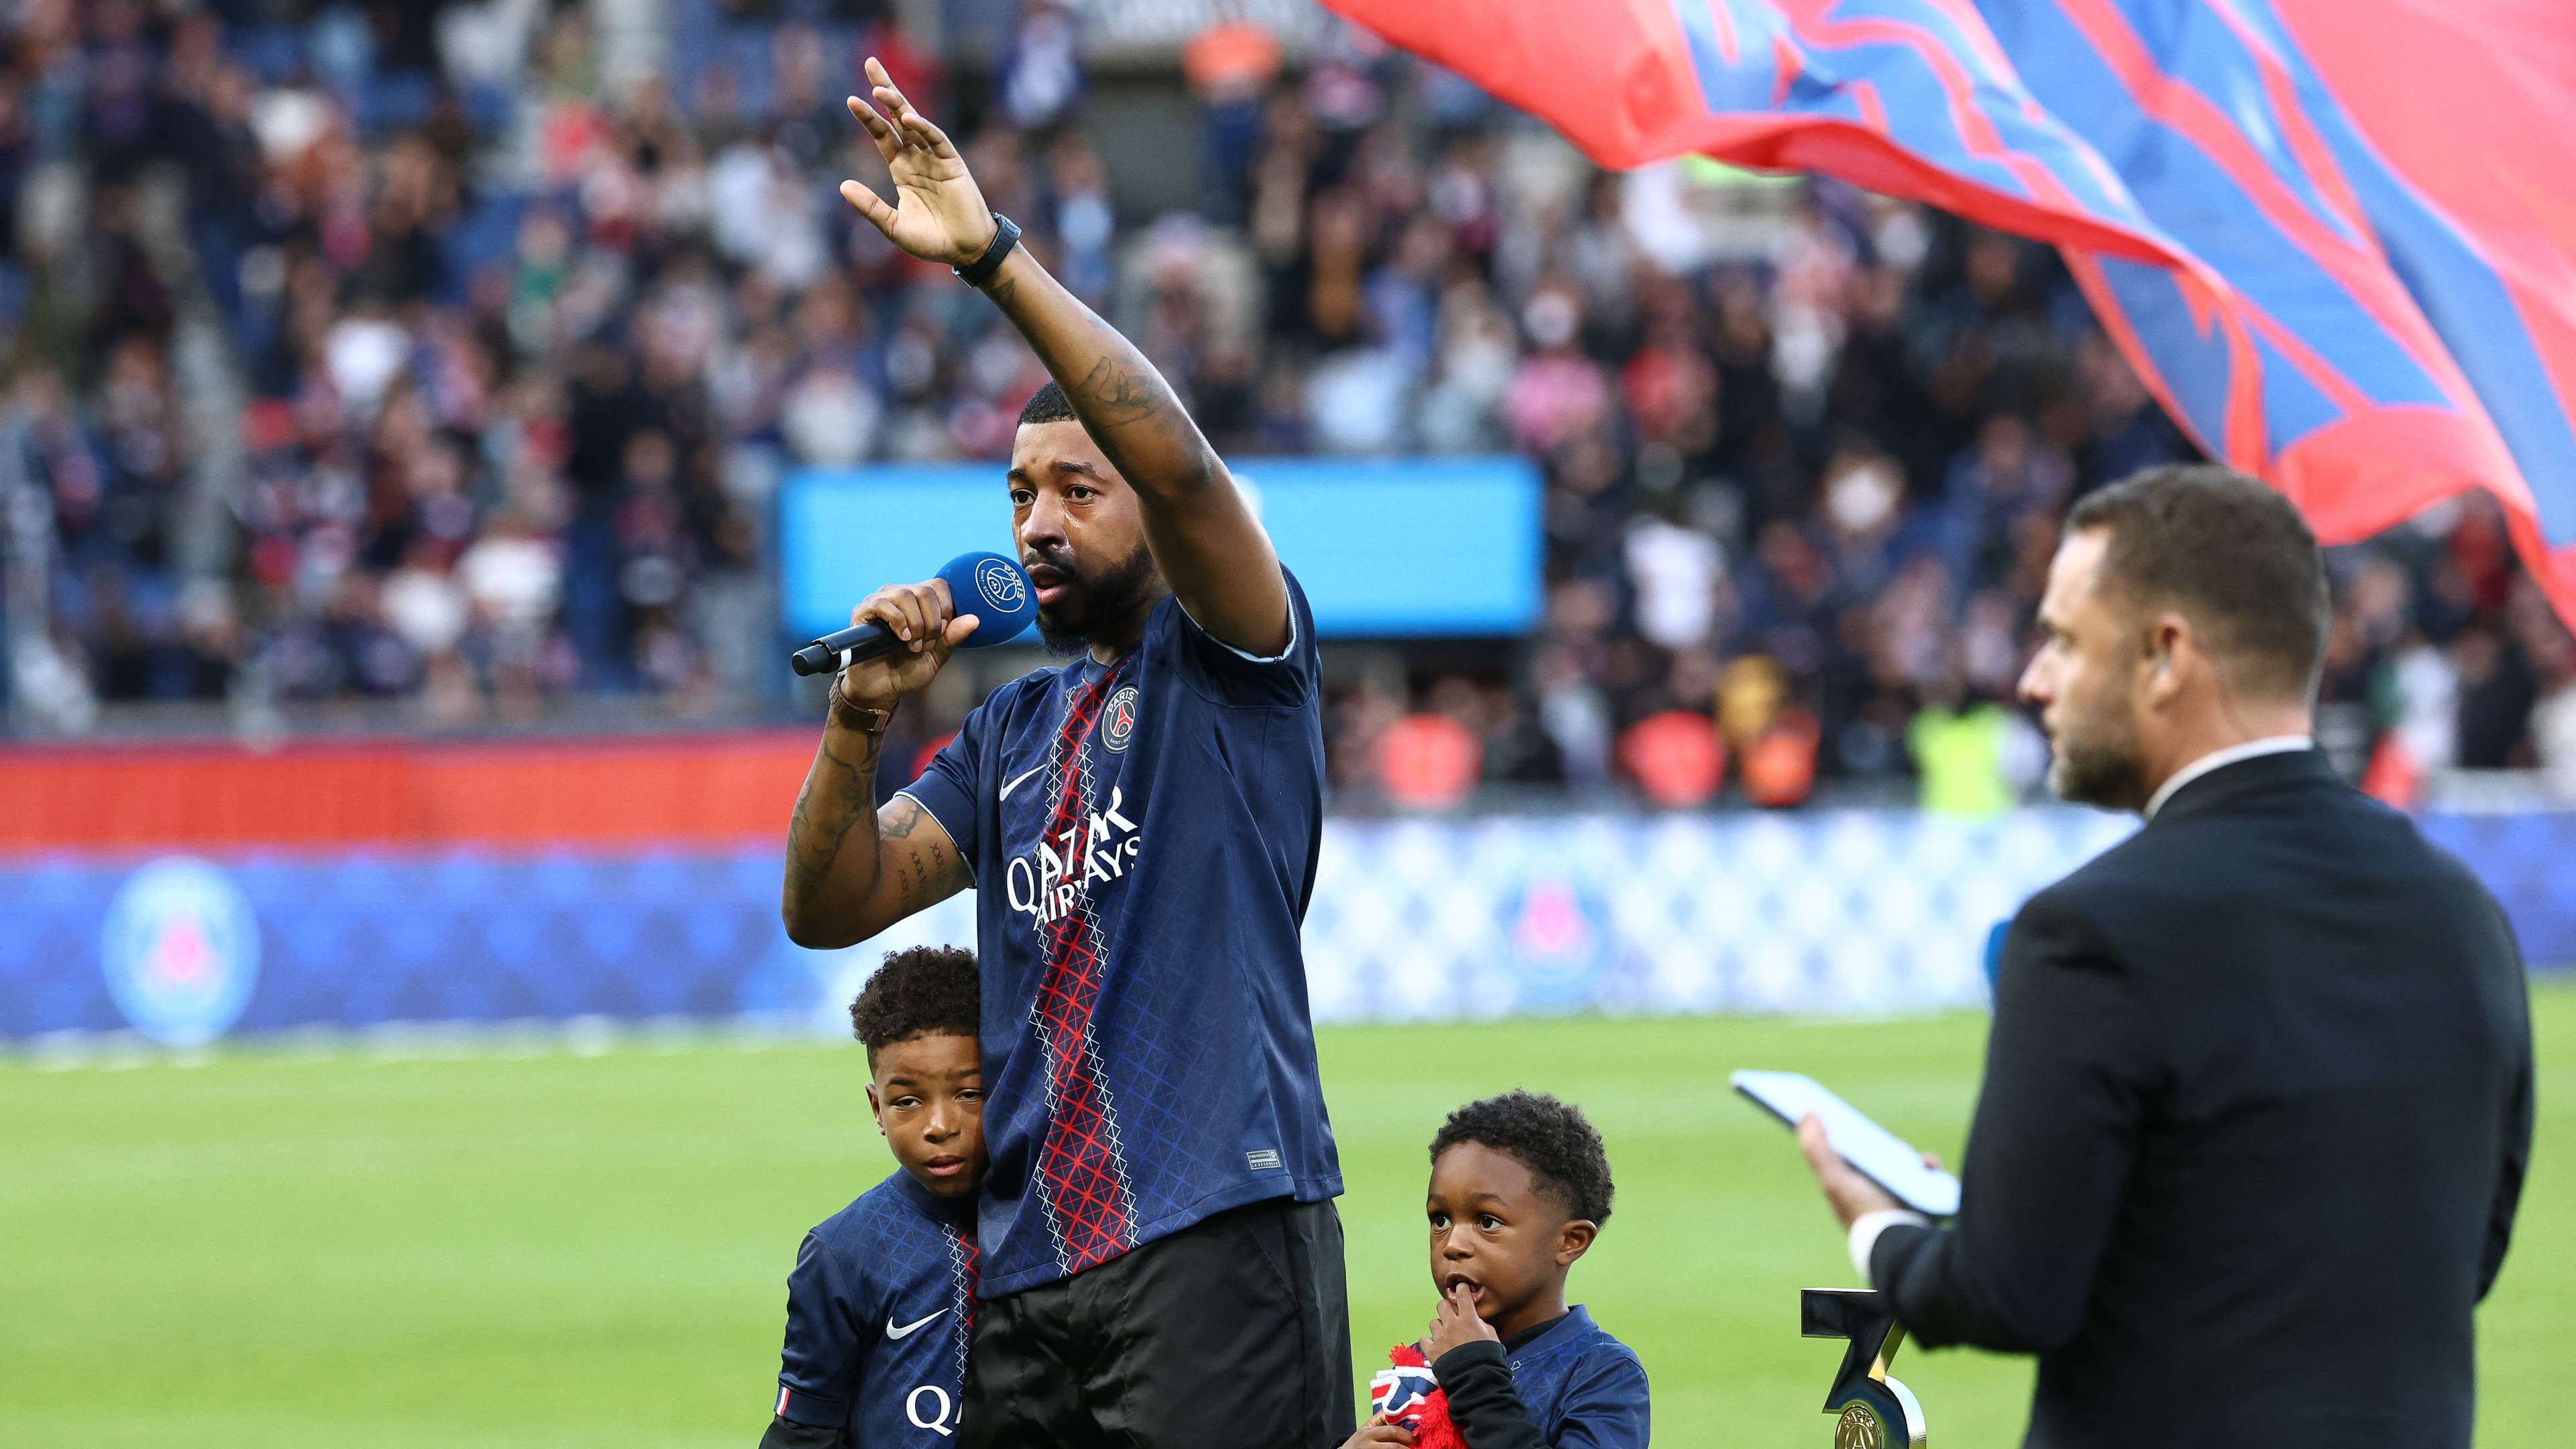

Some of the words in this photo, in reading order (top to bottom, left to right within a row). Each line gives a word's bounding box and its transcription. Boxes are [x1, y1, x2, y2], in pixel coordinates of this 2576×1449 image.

[1004, 564, 1024, 600] PARIS
[1108, 690, 1134, 713] PARIS
[1032, 836, 1140, 931] AIRAYS
